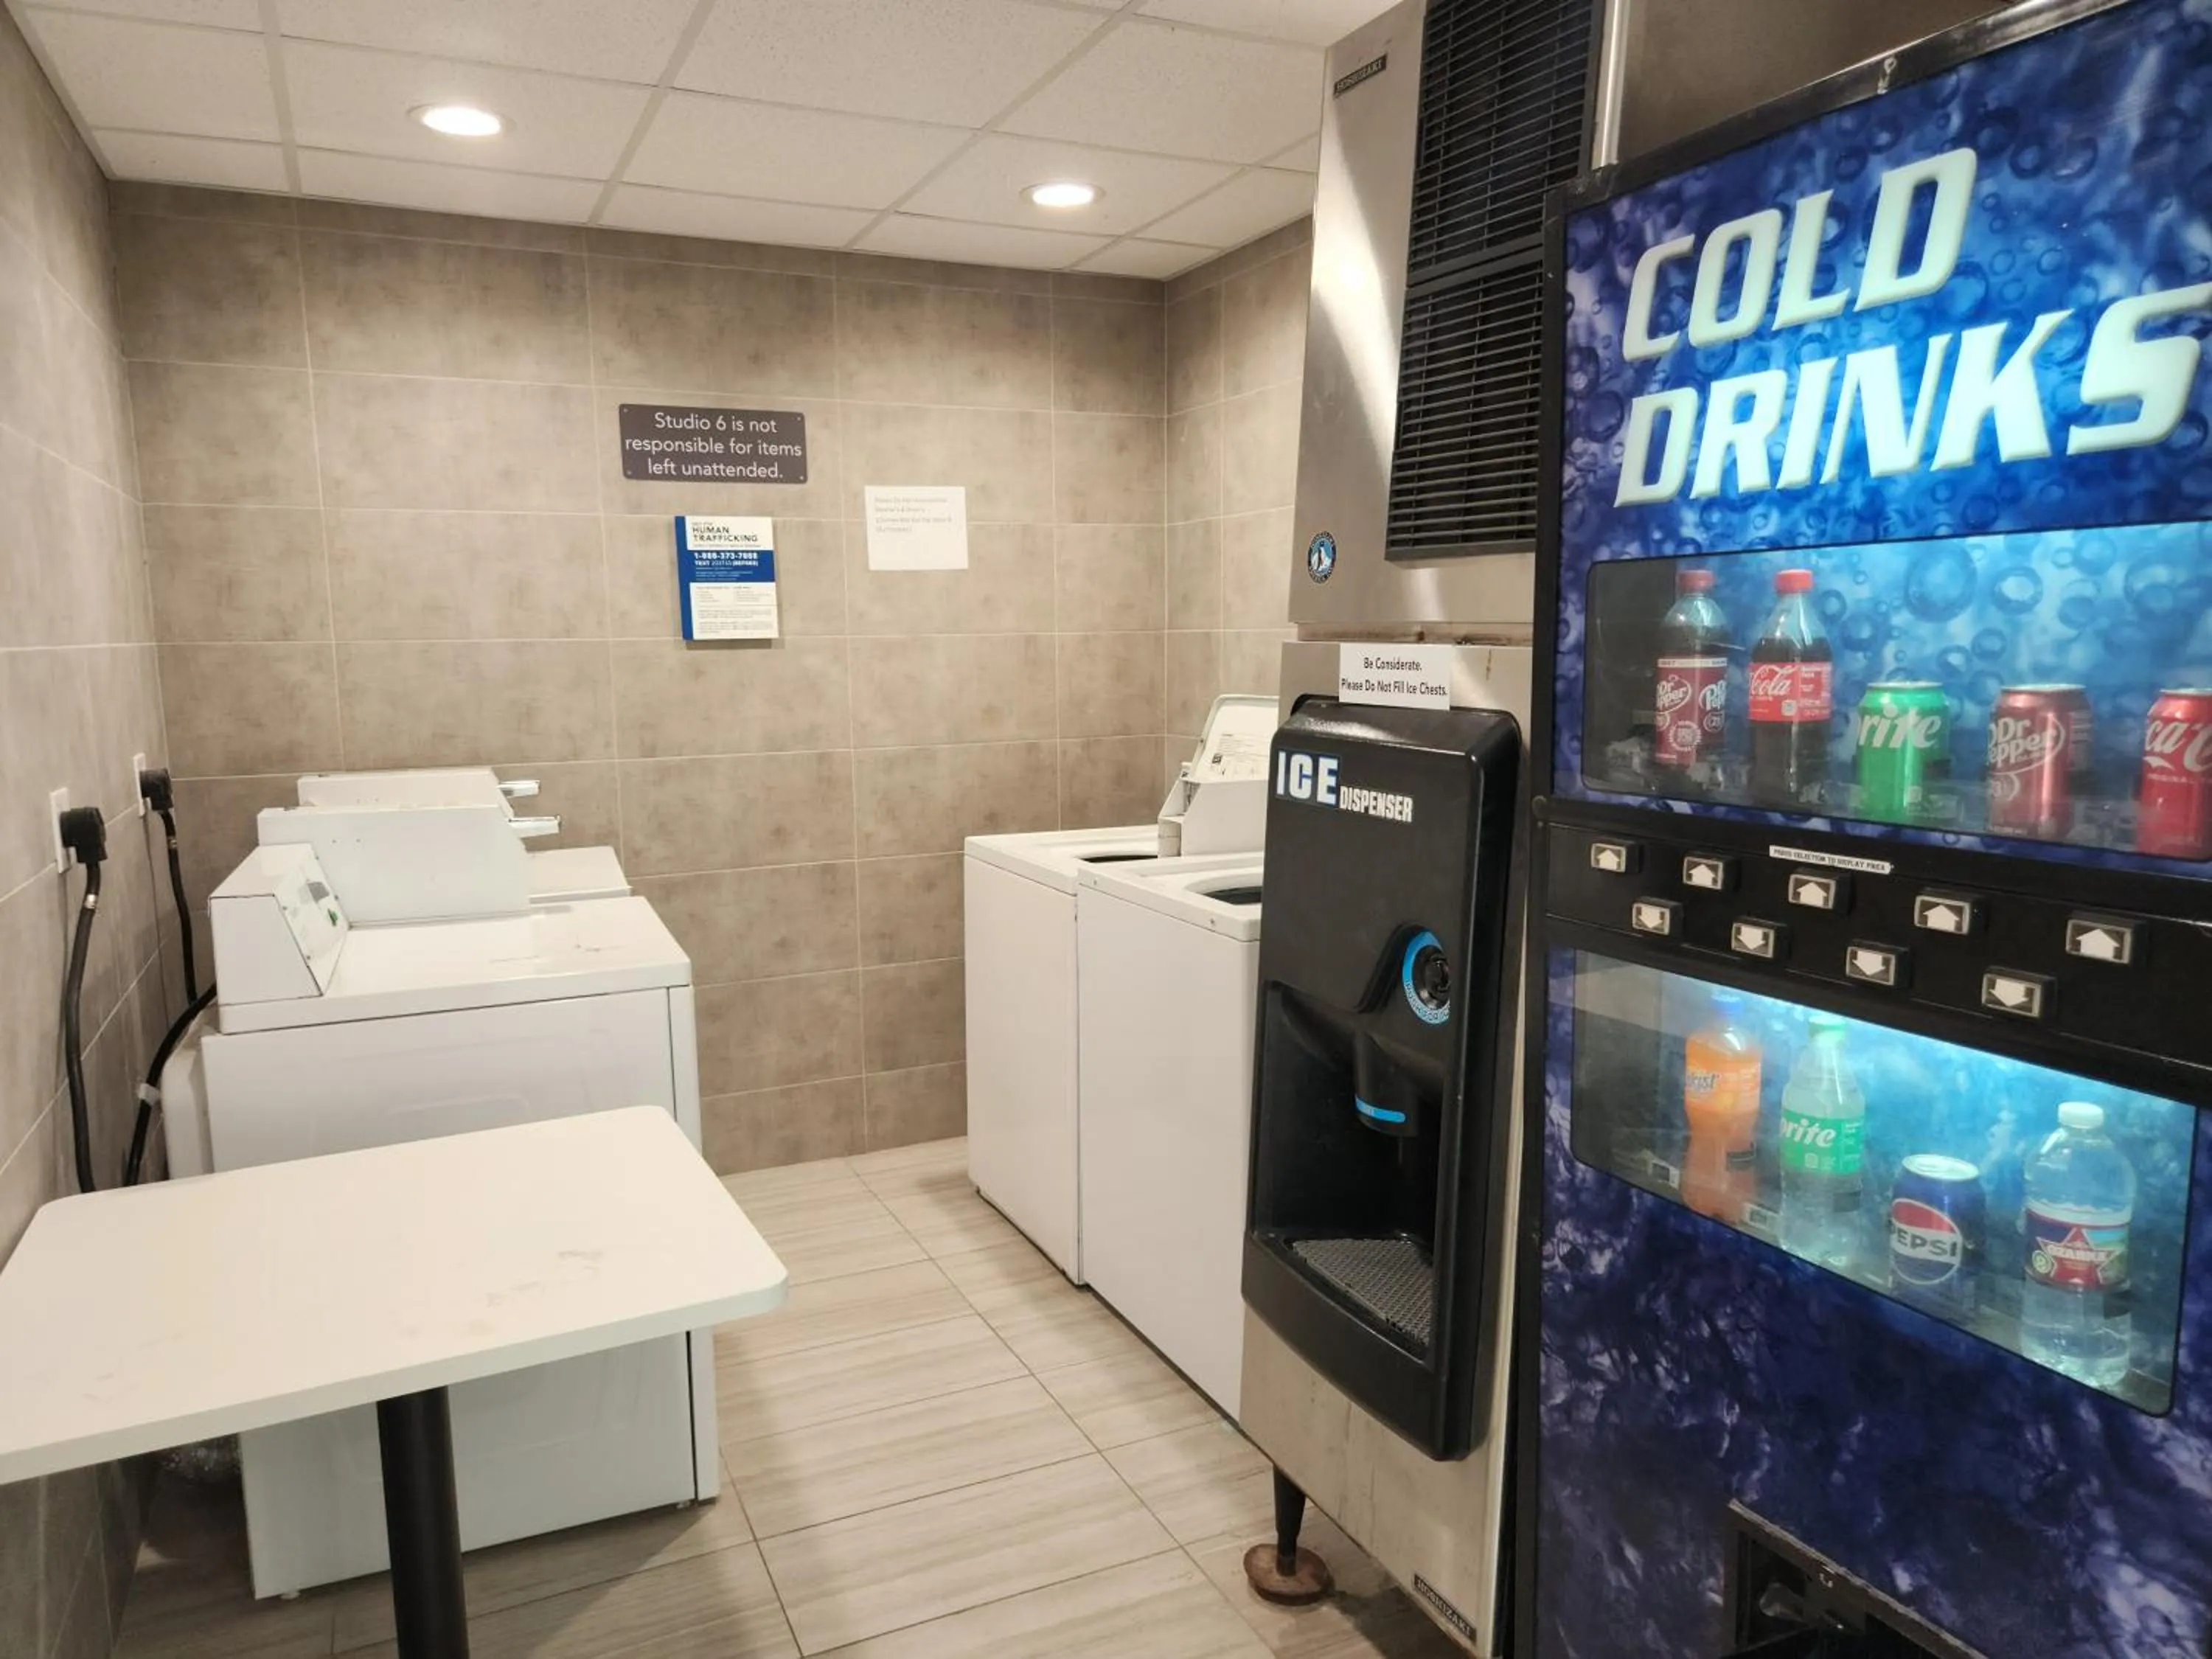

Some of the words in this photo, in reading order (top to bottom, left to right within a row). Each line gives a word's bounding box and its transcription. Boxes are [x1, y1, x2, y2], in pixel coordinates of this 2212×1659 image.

[1623, 147, 1978, 362] COLD
[1613, 282, 2212, 509] DRINKS
[653, 411, 712, 430] Studio
[716, 415, 727, 431] 6
[731, 416, 745, 431] is
[749, 420, 778, 434] not
[625, 437, 725, 454] responsible
[729, 438, 754, 454] for
[758, 440, 803, 456] items
[647, 458, 677, 476] left
[681, 462, 784, 479] unattended.
[692, 526, 730, 534] HUMAN
[693, 534, 759, 543] TRAFFICKING
[1363, 657, 1374, 669] Be
[1375, 657, 1422, 672] Considerate.
[1341, 678, 1363, 692] Please
[1365, 679, 1375, 692] Do
[1377, 681, 1391, 693] Not
[1393, 681, 1405, 694] Fill
[1406, 681, 1417, 695] Ice
[1859, 703, 1941, 748] rite
[1997, 716, 2031, 745] Dr
[1276, 751, 1340, 806] ICE
[1339, 785, 1413, 824] DISPENSER
[1781, 1118, 1837, 1147] rite
